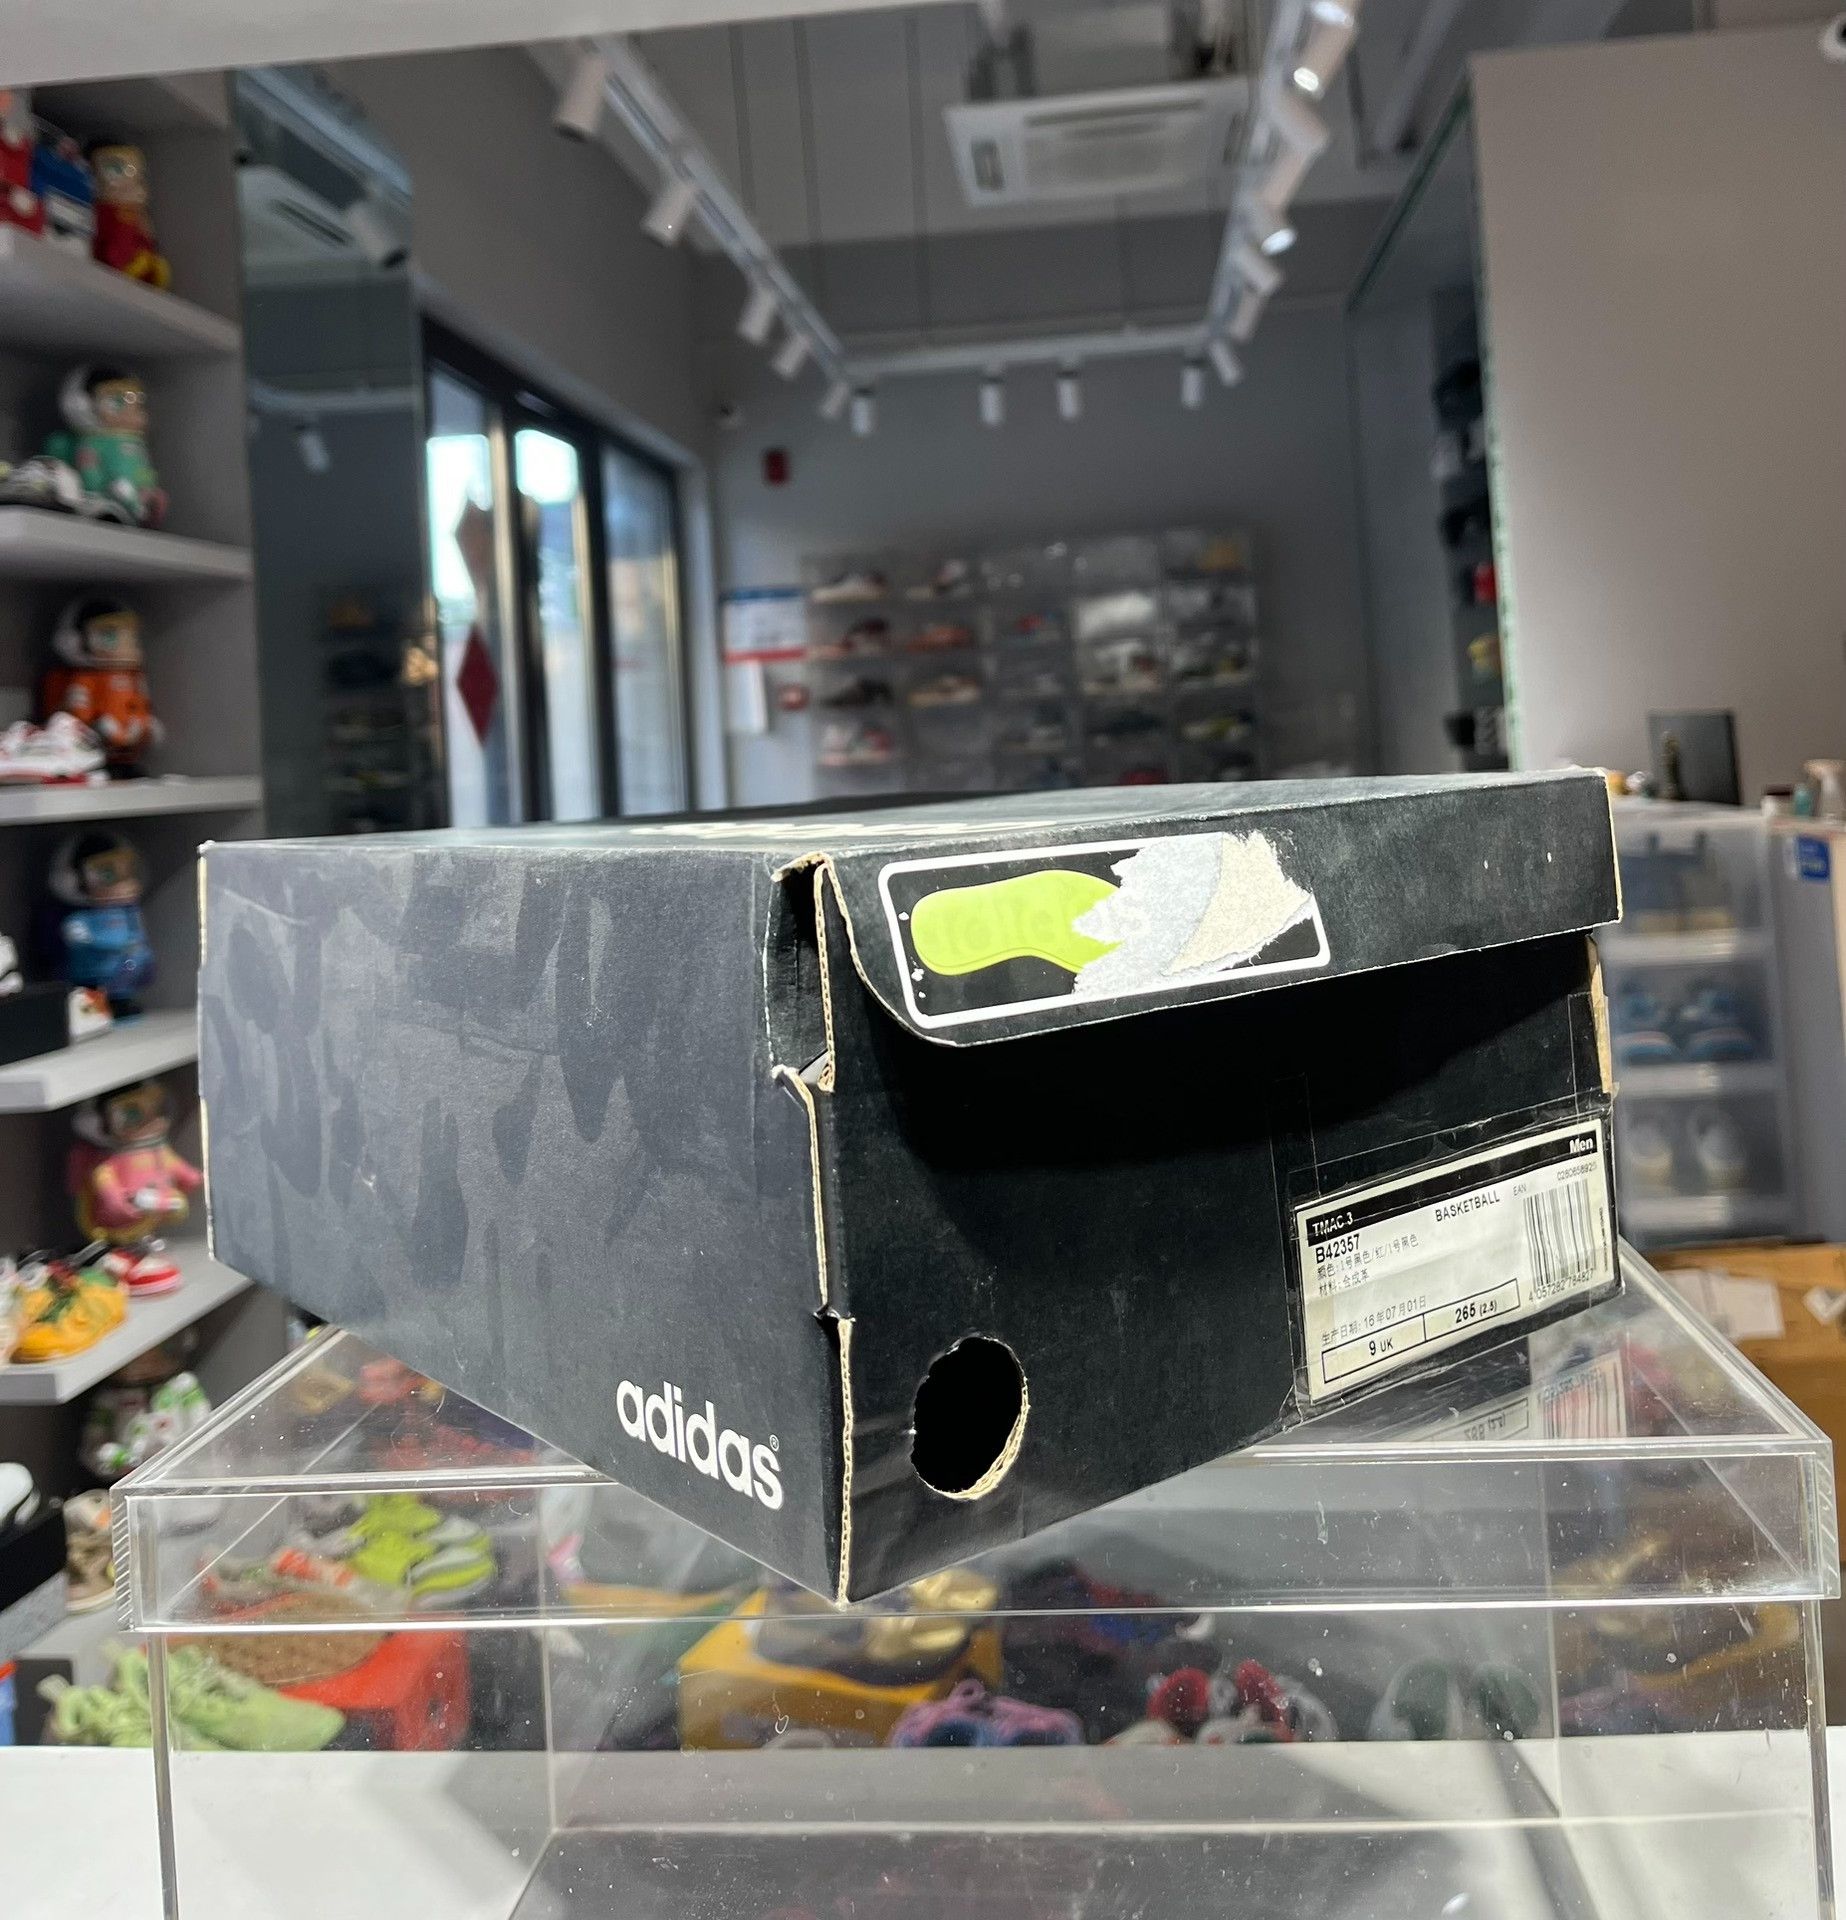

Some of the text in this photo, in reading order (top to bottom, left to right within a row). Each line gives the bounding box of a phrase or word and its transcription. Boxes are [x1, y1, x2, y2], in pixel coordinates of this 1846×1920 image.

[1569, 1137, 1594, 1153] Men
[1513, 1184, 1528, 1196] EAN
[1435, 1190, 1500, 1222] BASKETBALL
[1312, 1215, 1345, 1237] TMAC
[1315, 1233, 1361, 1264] B42357
[1368, 1300, 1498, 1356] 9 UK 265 (2.5)
[616, 1380, 785, 1511] adidas
